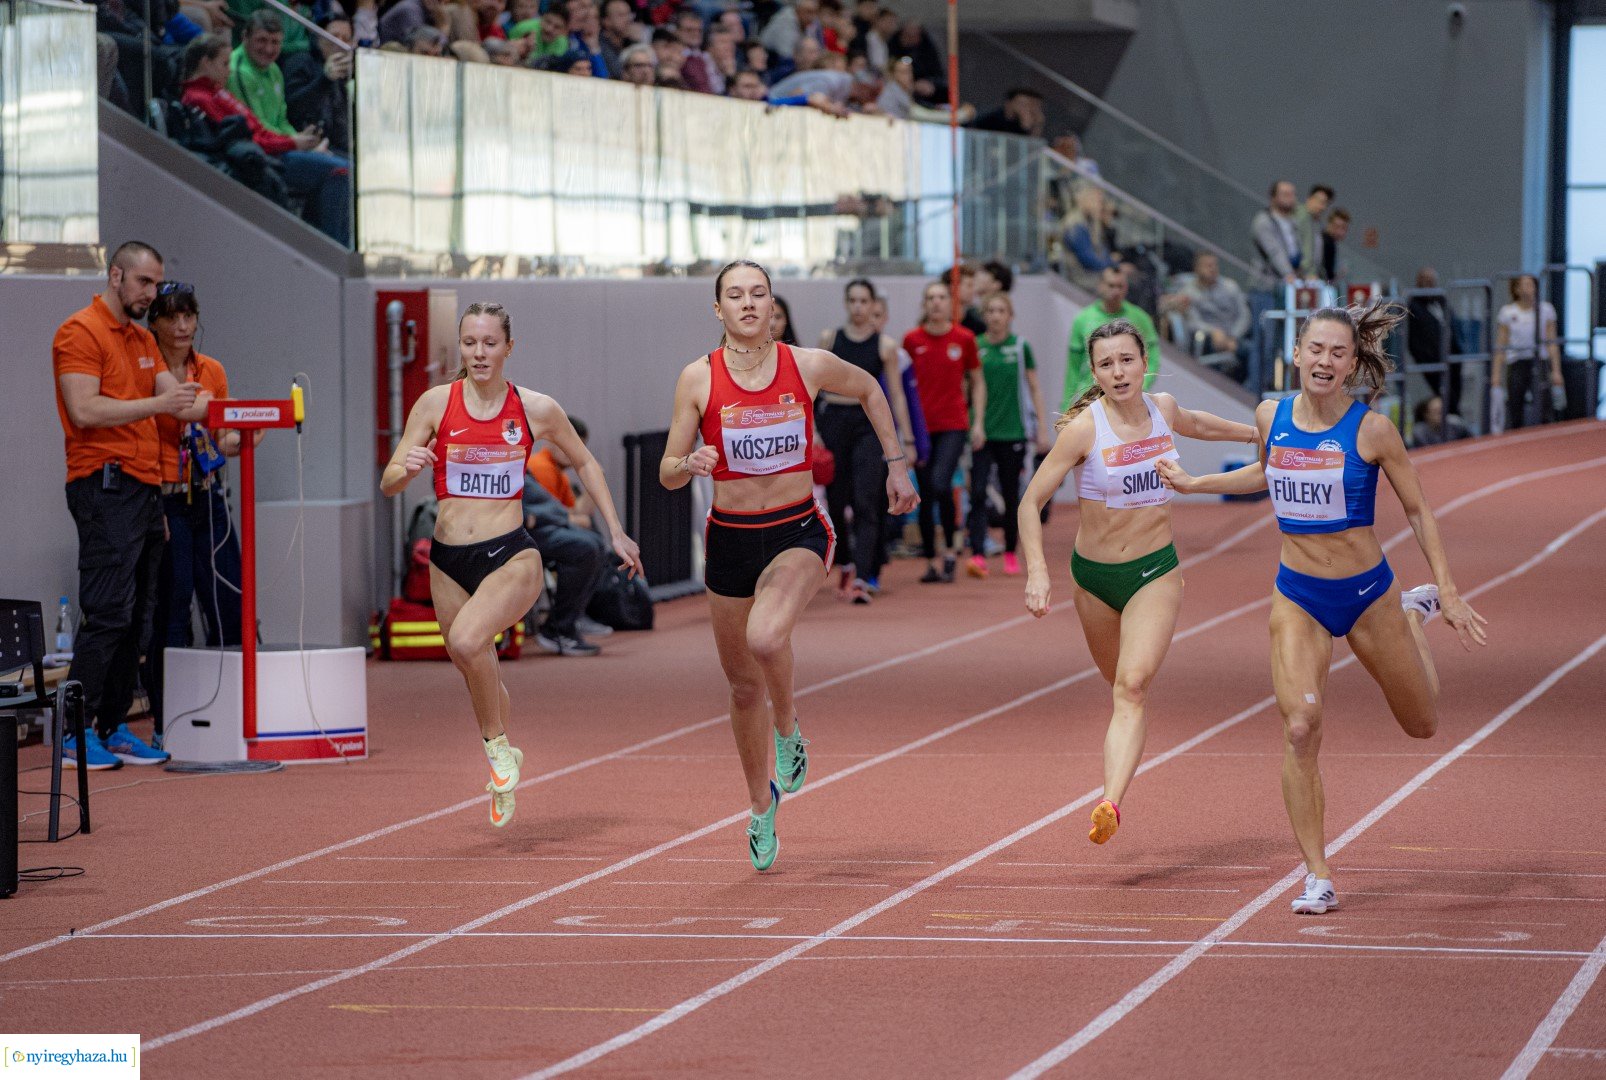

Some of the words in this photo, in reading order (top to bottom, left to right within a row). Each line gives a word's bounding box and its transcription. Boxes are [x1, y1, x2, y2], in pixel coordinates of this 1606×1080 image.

[732, 434, 800, 460] KŐSZEGI
[460, 470, 511, 495] BATHÓ
[1122, 469, 1164, 495] SIMO
[1273, 476, 1333, 505] FÜLEKY
[553, 915, 785, 929] 5
